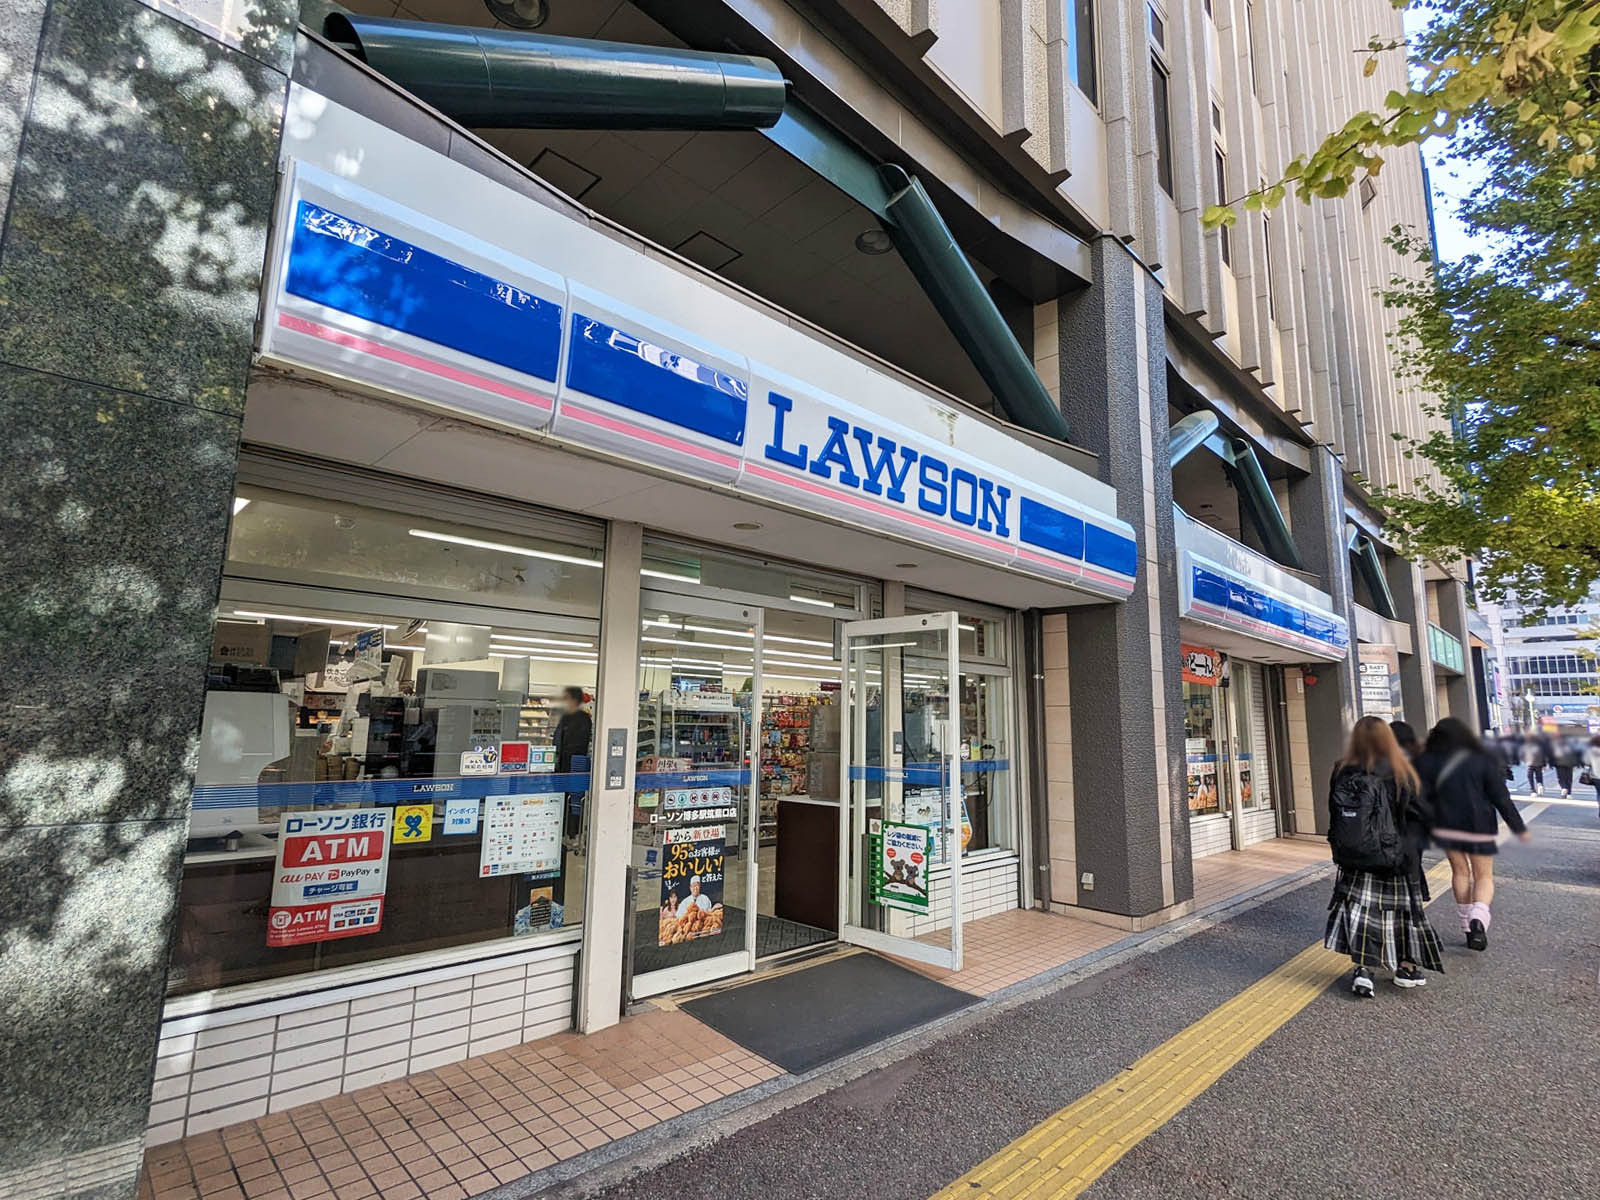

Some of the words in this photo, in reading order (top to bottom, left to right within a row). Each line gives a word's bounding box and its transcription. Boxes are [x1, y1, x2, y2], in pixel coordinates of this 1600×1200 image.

[765, 391, 1012, 537] LAWSON
[413, 783, 454, 793] LAWSON
[448, 807, 477, 815] インボイス
[285, 813, 386, 834] ローソン銀行
[300, 836, 369, 863] ATM
[280, 873, 303, 883] au
[304, 871, 326, 881] PAY
[340, 868, 372, 878] PayPay
[663, 855, 724, 879] おいしい!
[292, 909, 328, 925] ATM
